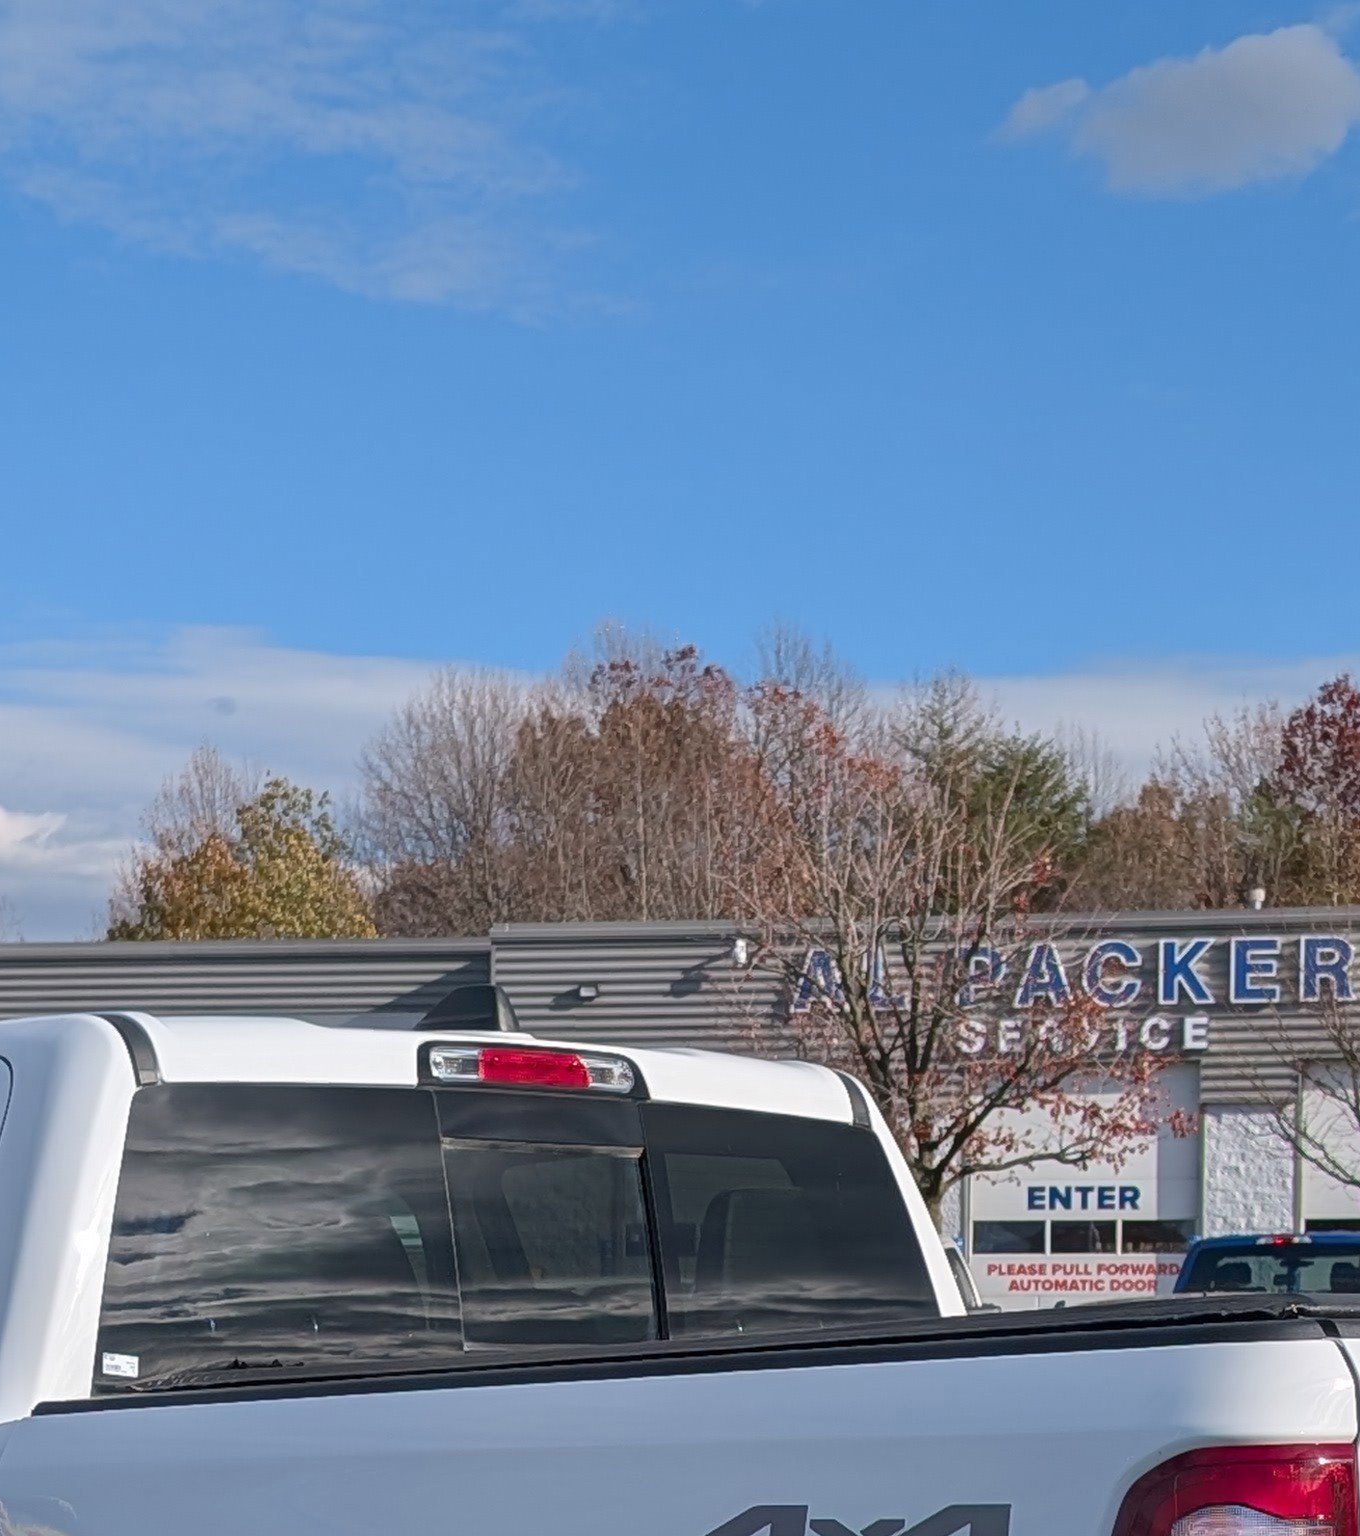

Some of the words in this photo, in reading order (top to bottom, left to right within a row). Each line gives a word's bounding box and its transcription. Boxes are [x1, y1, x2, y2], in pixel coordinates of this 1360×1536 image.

[790, 944, 911, 1013] AL
[956, 935, 1357, 1009] PACKER
[1027, 1186, 1141, 1211] ENTER
[987, 1263, 1047, 1276] PLEASE
[1051, 1263, 1091, 1276] PULL
[1096, 1263, 1180, 1276] FORWARD
[1008, 1279, 1106, 1292] AUTOMATIC
[1110, 1279, 1158, 1292] DOOR
